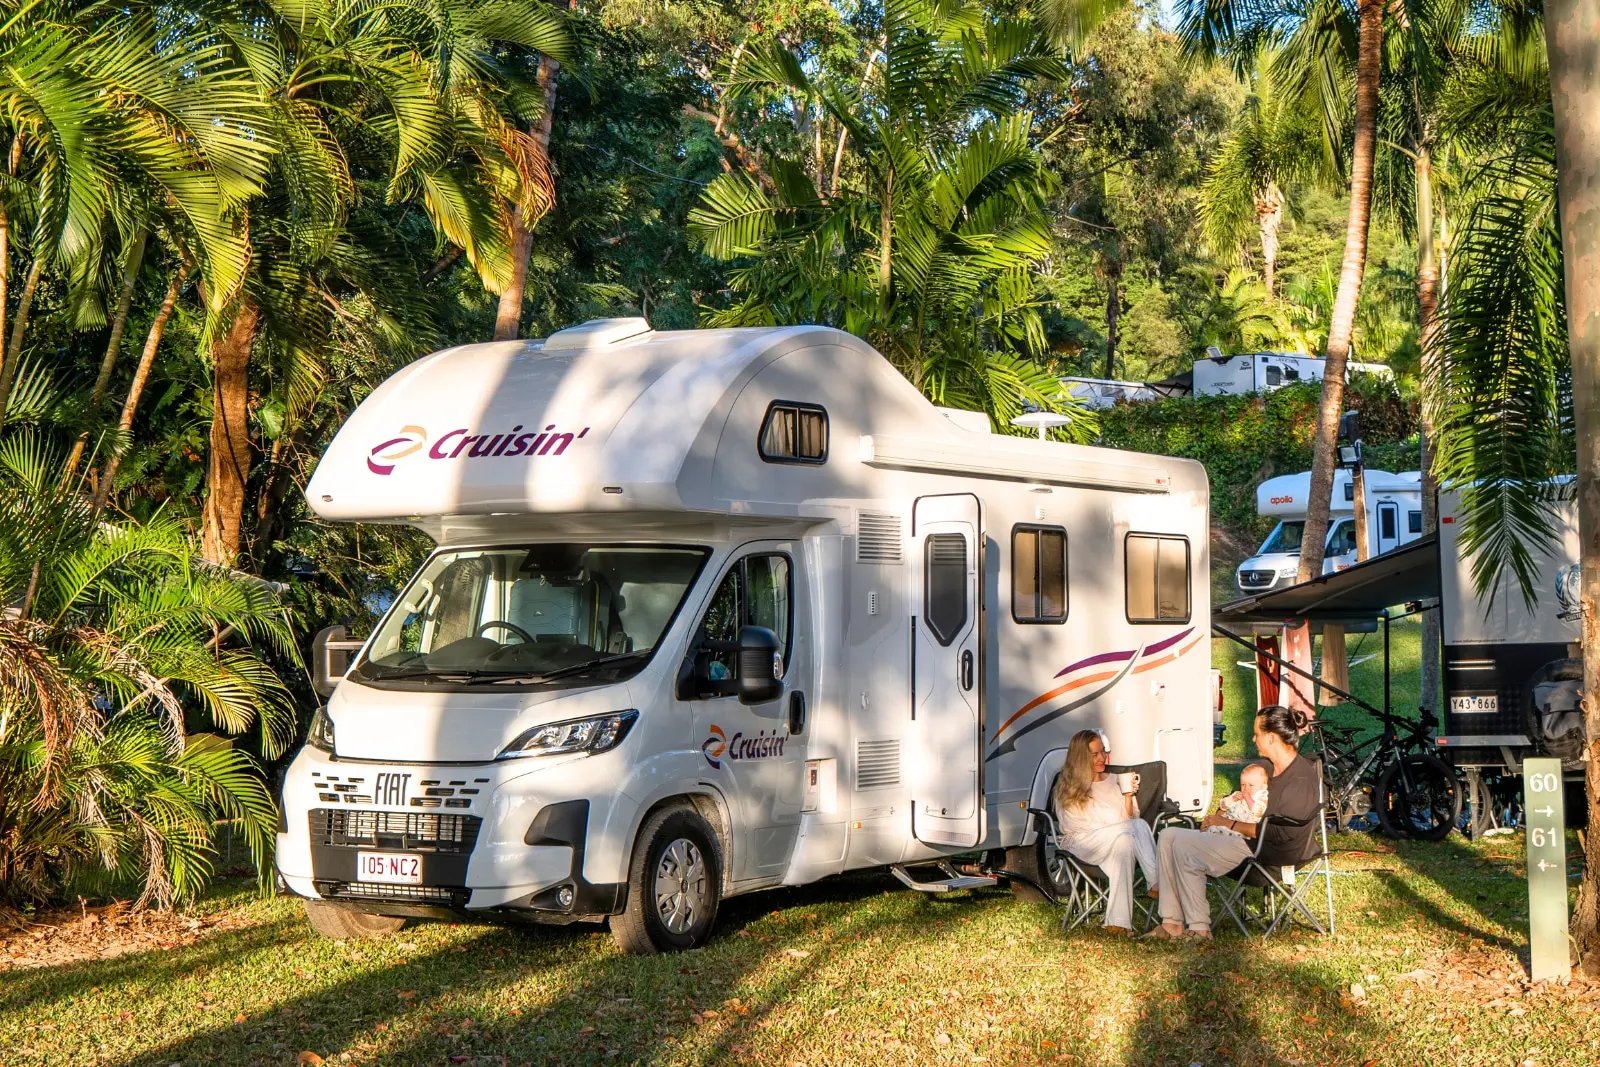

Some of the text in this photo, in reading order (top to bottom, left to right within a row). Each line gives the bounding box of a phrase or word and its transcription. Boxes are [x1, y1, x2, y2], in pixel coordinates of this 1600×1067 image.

[429, 424, 591, 460] Cruisin'
[1270, 495, 1293, 506] apollo
[1452, 698, 1496, 710] Y43 866
[729, 729, 789, 760] Cruisin'
[375, 772, 412, 806] FIAT
[1529, 772, 1558, 793] 60
[1531, 826, 1557, 848] 61
